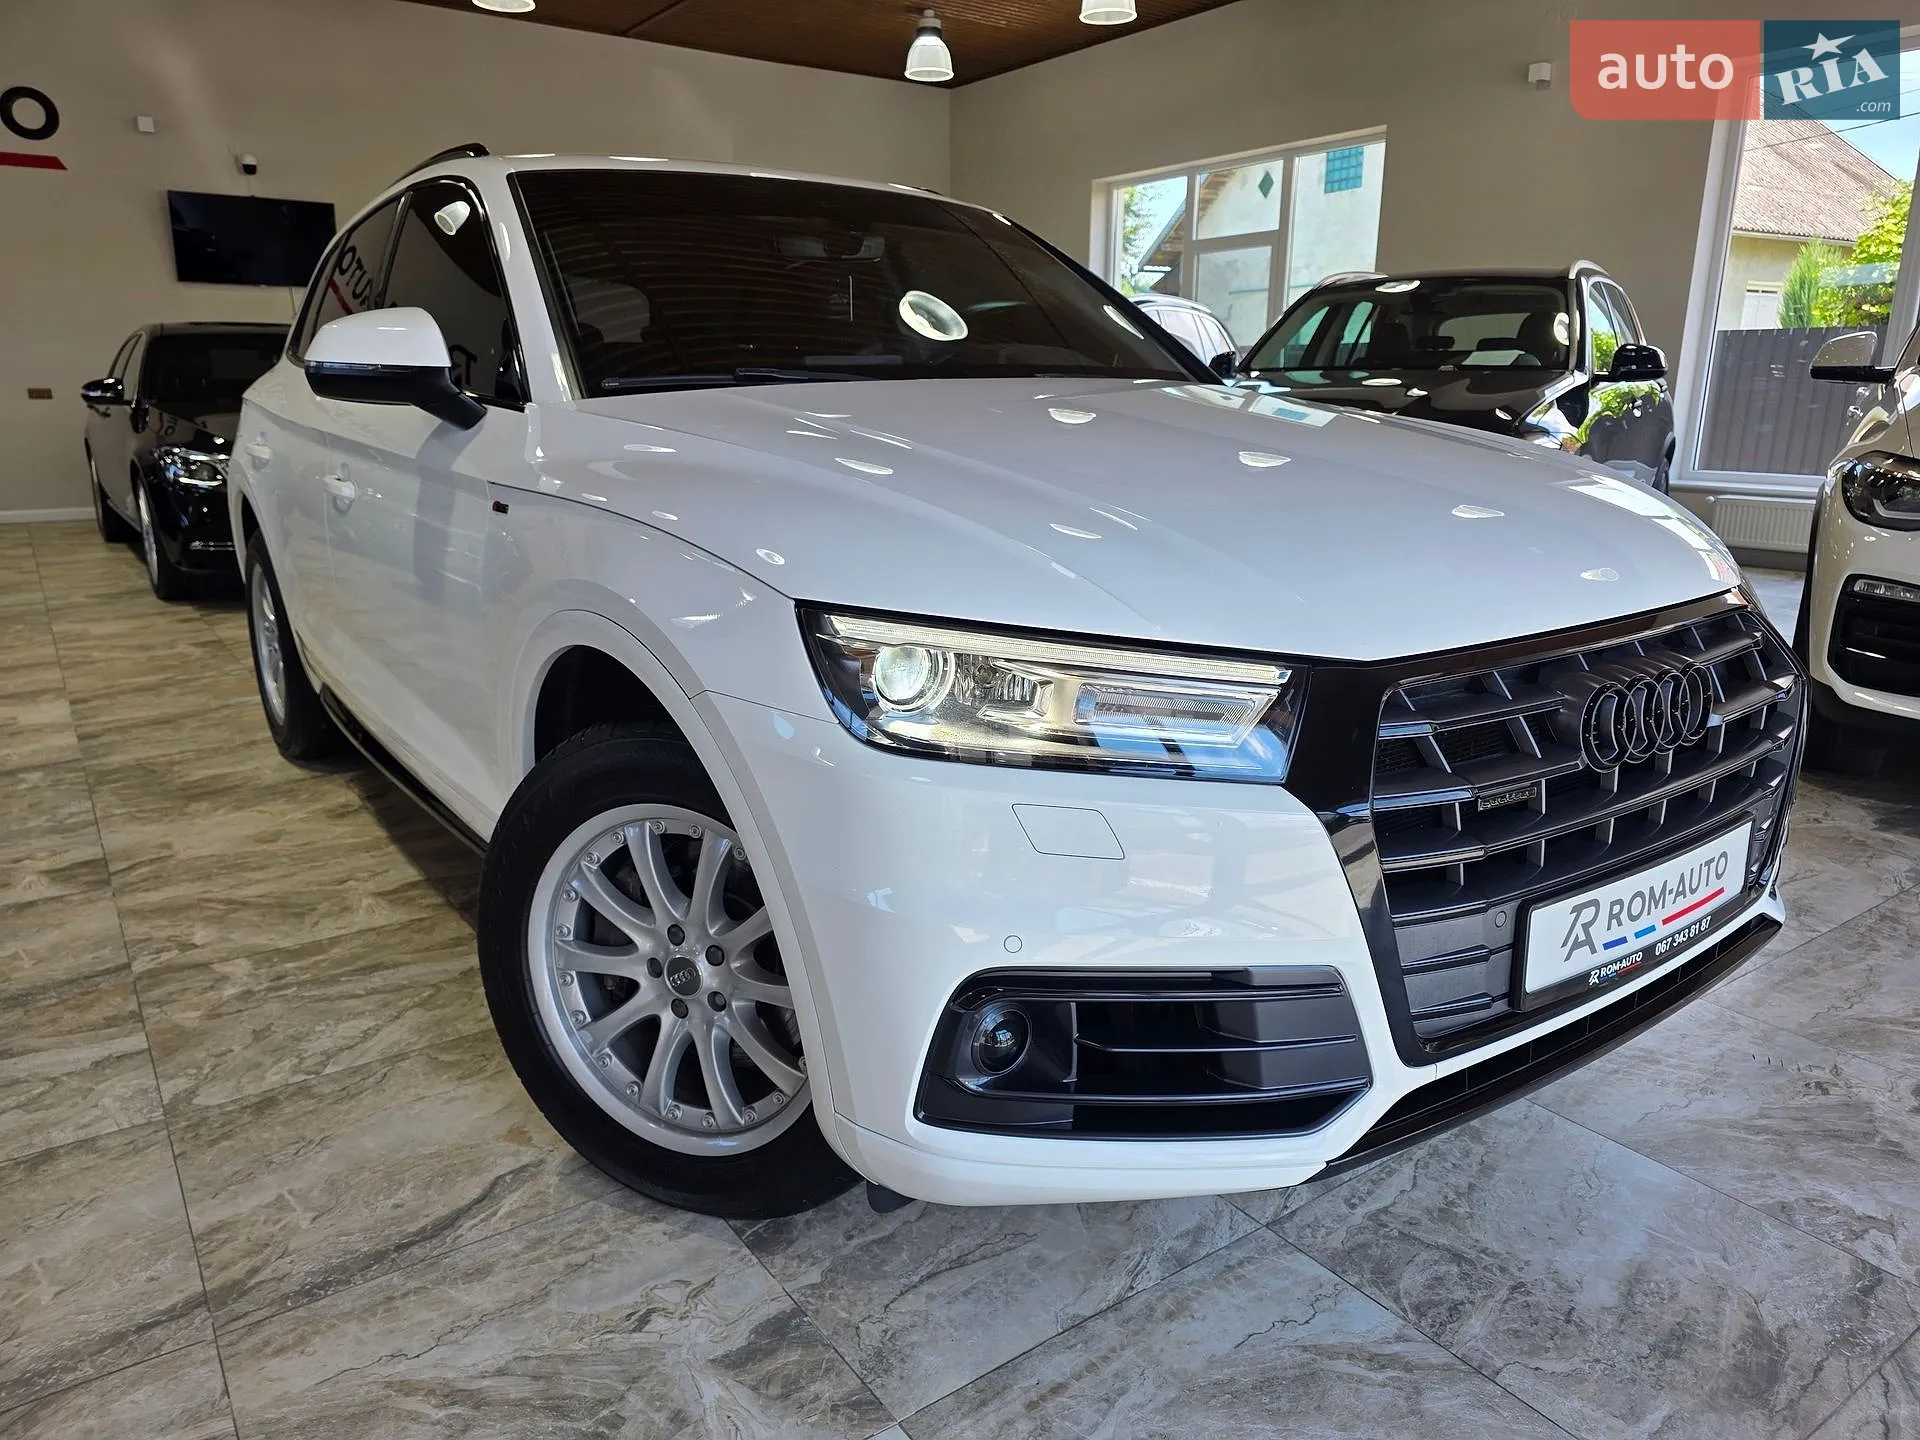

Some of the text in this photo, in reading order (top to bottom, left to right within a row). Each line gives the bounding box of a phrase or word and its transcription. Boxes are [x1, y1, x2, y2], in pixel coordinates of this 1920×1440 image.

[1606, 850, 1729, 932] ROM-AUTO
[1655, 937, 1672, 956] 067
[1673, 928, 1689, 947] 343
[1690, 922, 1700, 938] 81
[1600, 951, 1643, 978] ROM-AUTO
